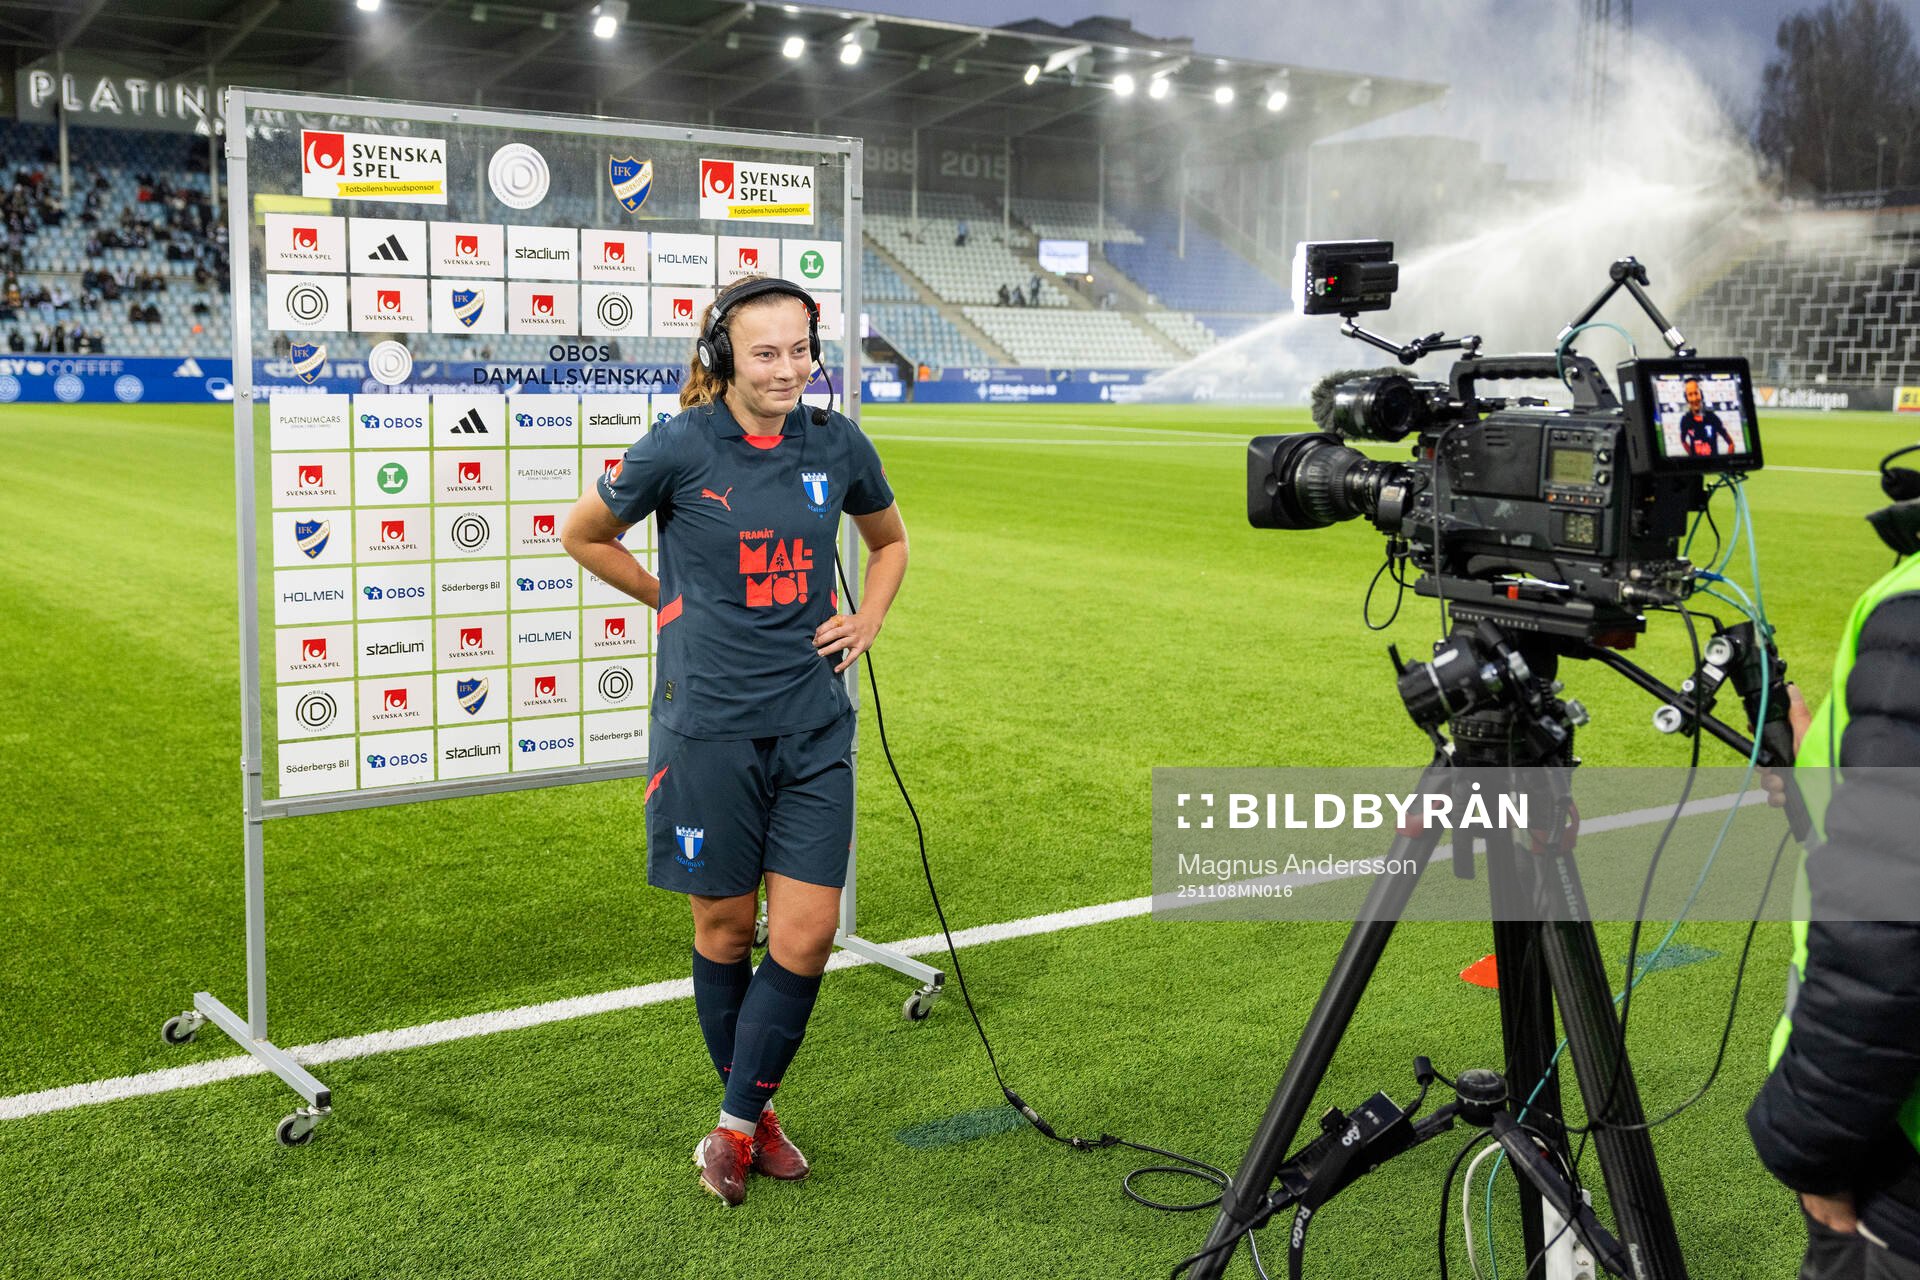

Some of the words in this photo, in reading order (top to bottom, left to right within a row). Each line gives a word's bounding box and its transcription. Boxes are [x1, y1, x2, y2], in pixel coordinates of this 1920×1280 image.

[352, 144, 442, 165] SVENSKA
[863, 147, 918, 173] 989
[352, 162, 400, 180] SPEL
[614, 166, 632, 176] IFK
[740, 171, 811, 188] SVENSKA
[346, 185, 383, 193] Fotbollens
[384, 184, 434, 194] huvudsponsor
[740, 187, 778, 203] SPEL
[764, 206, 805, 215] huvudsponsor
[515, 247, 570, 260] stadium
[658, 254, 708, 265] HOLMEN
[294, 349, 309, 357] IFK
[550, 345, 610, 362] OBOS
[474, 368, 680, 385] DAMALLSVENSKAN
[280, 415, 341, 424] PLATINUMCARS
[384, 418, 422, 428] OBOS
[537, 416, 572, 427] OBOS
[589, 414, 641, 425] stadium
[518, 468, 571, 477] PLATINUMCARS
[298, 526, 313, 534] IFK
[740, 528, 774, 540] FRAMÅT
[442, 582, 488, 592] Söderbergs
[538, 578, 573, 590] OBOS
[746, 572, 808, 608] MÖ!
[284, 590, 344, 602] HOLMEN
[386, 587, 425, 599] OBOS
[519, 631, 572, 643] HOLMEN
[366, 641, 424, 656] stadium
[590, 732, 632, 741] Söderbergs
[539, 738, 574, 750] OBOS
[446, 743, 501, 760] stadium
[389, 753, 427, 766] OBOS
[286, 762, 336, 773] Söderbergs
[339, 760, 349, 768] Bil
[1292, 1206, 1312, 1248] ReGo
